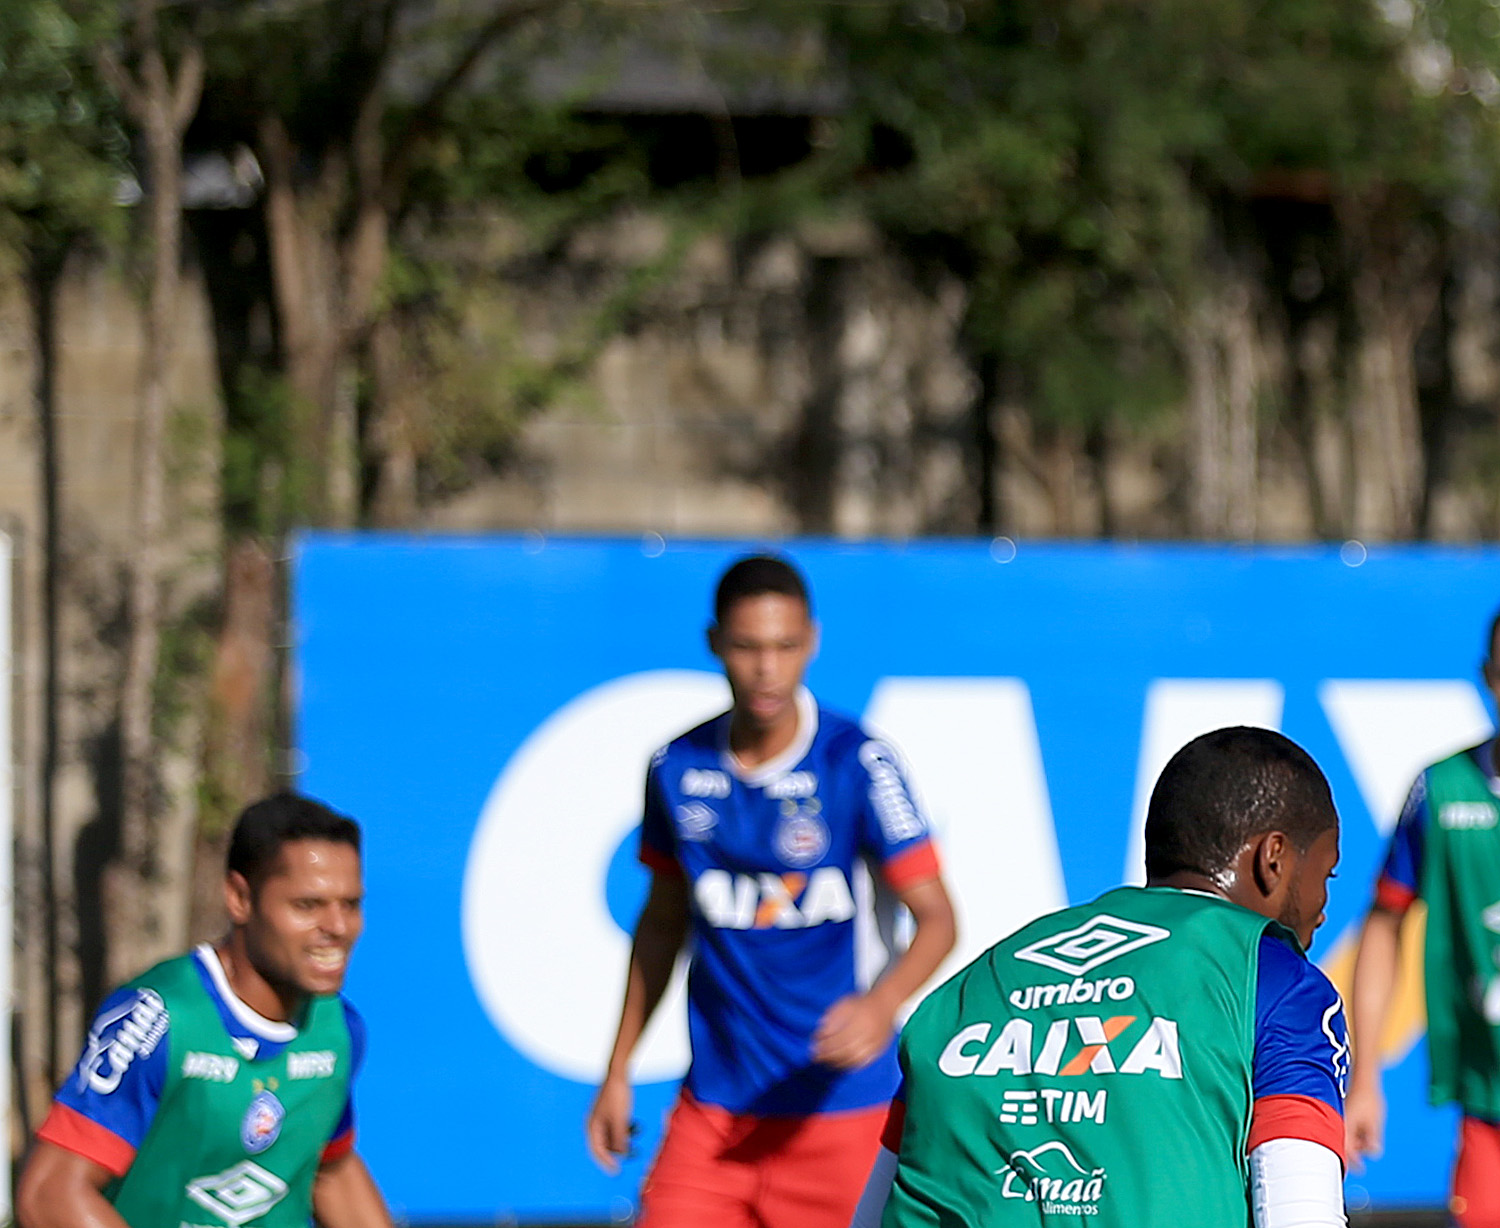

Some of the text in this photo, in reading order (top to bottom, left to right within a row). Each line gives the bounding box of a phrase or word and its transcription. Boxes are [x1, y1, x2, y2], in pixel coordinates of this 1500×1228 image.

[1009, 976, 1136, 1010] umbro
[938, 1015, 1183, 1080] CAIXA
[1040, 1089, 1107, 1124] TIM
